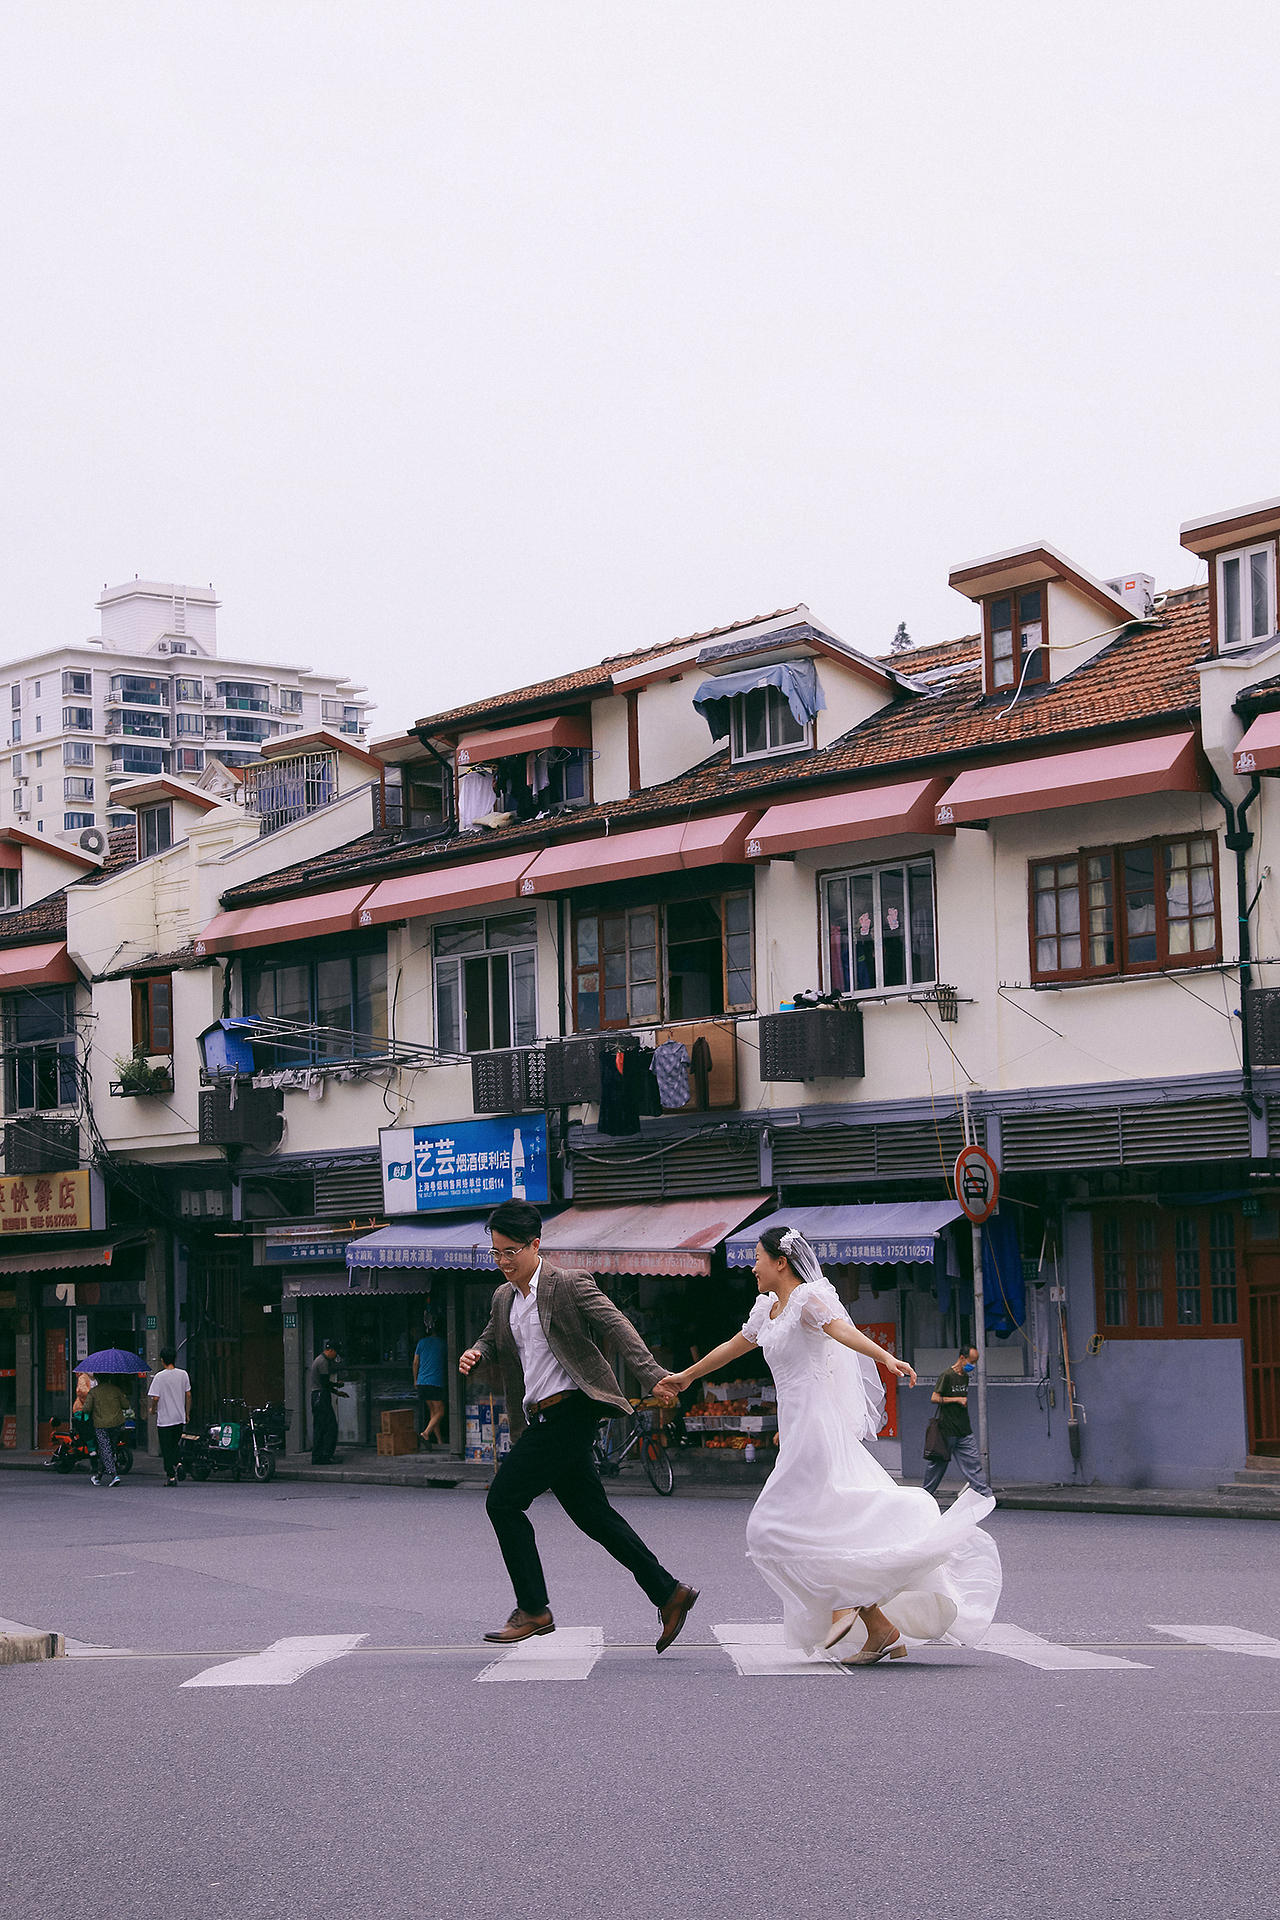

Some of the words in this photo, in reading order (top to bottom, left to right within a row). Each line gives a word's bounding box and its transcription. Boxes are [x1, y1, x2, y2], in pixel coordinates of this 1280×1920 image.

[1241, 1199, 1258, 1211] 210
[291, 1248, 347, 1258] 上海卷烟销售
[737, 1247, 756, 1260] 水滴
[1022, 1263, 1036, 1274] 212
